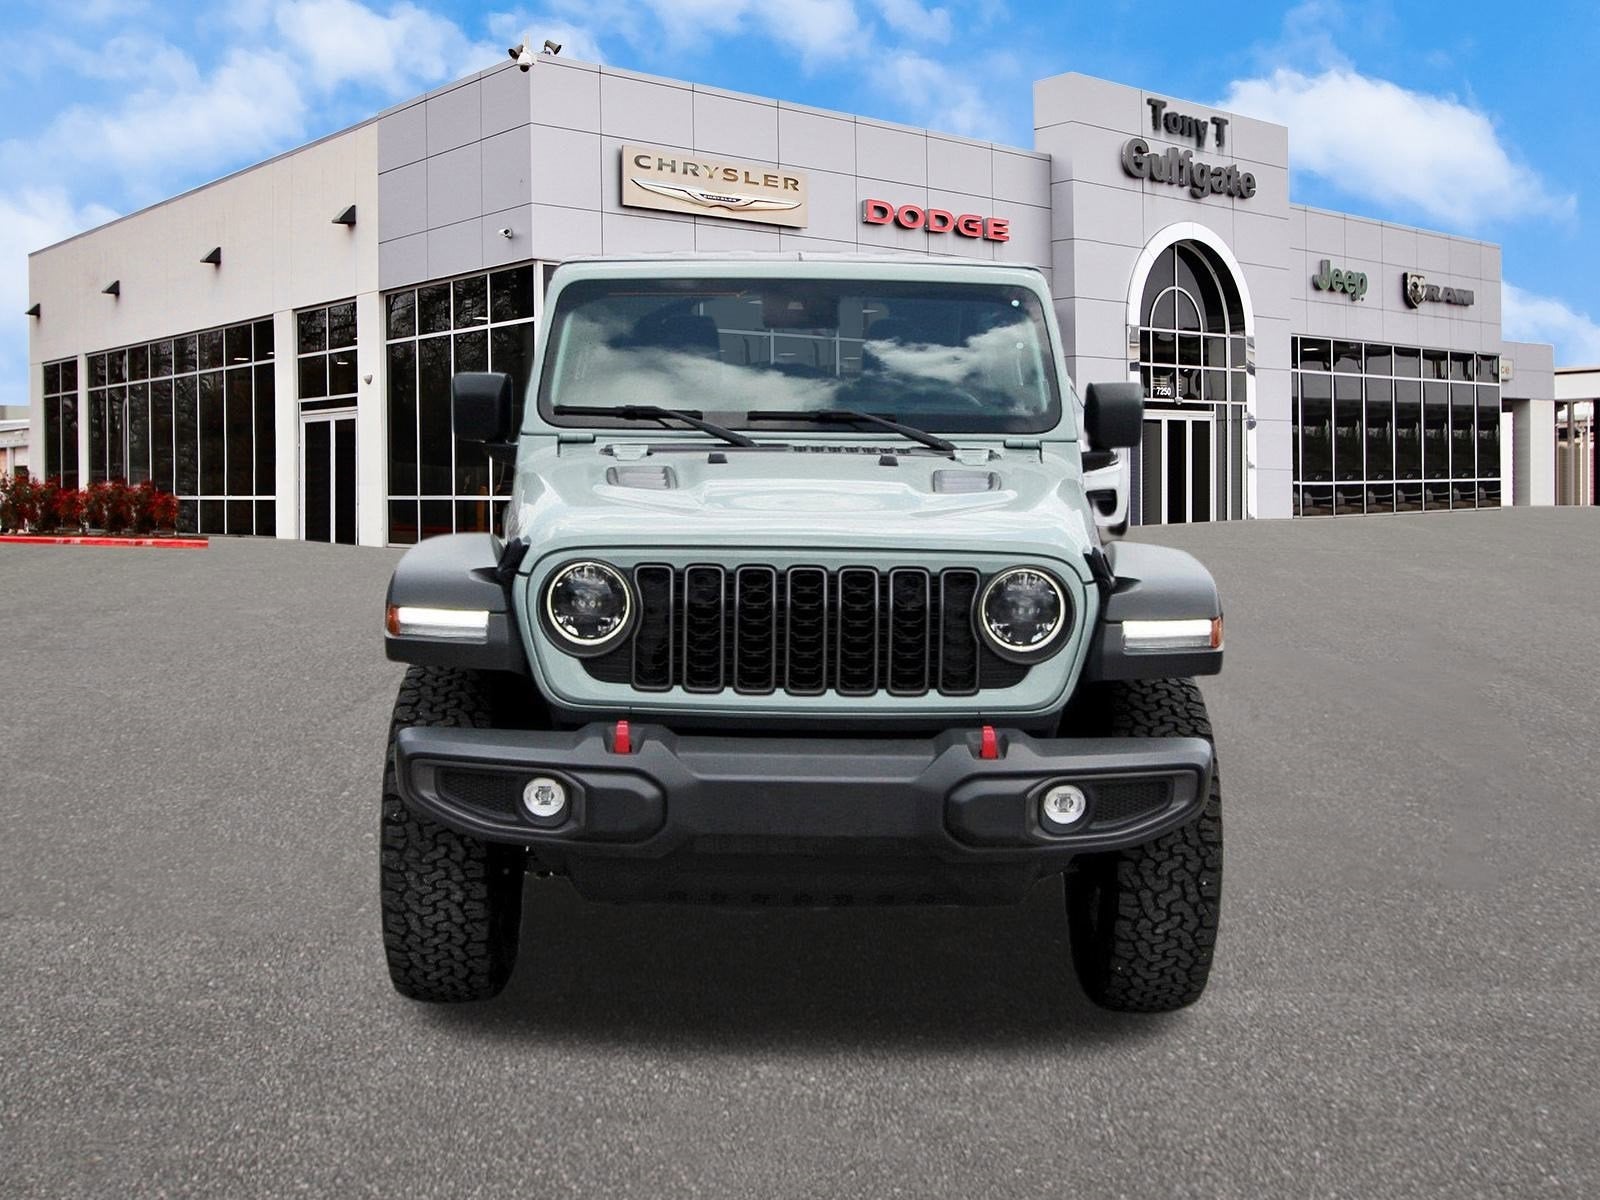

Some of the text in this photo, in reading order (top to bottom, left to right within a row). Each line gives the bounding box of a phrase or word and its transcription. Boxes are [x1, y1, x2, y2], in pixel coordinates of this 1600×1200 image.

[1147, 98, 1229, 148] Tony T
[634, 154, 800, 191] CHRYSLER
[1121, 138, 1257, 198] Gulfgate
[863, 199, 1010, 241] DODGE
[1313, 260, 1367, 301] Jeep
[1425, 284, 1474, 306] RAM
[1156, 386, 1171, 396] 7250
